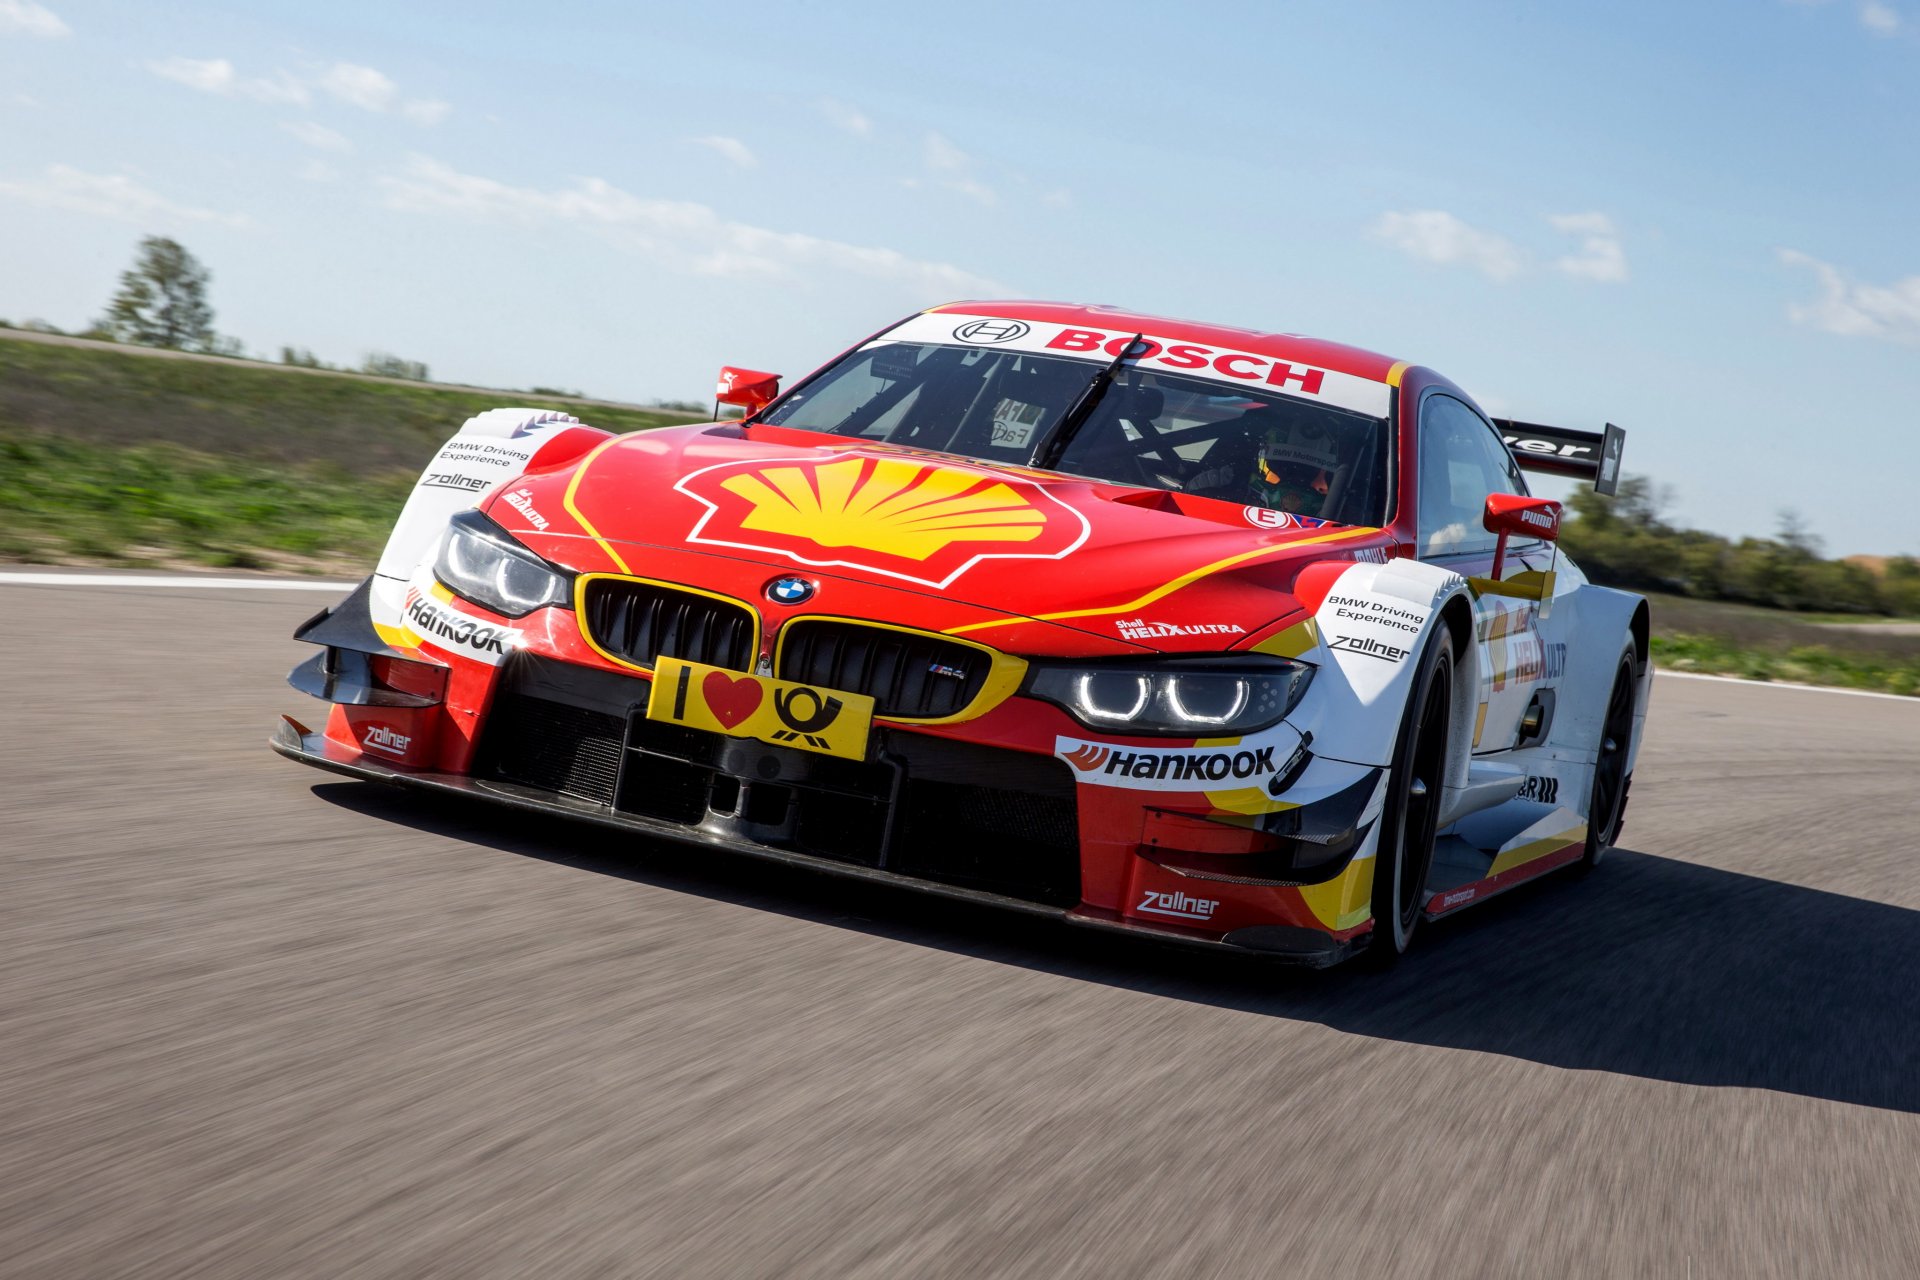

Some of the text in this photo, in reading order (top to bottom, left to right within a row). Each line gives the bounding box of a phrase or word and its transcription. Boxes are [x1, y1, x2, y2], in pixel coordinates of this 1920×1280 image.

[1044, 328, 1325, 395] BOSCH
[440, 451, 510, 467] Experience
[448, 442, 529, 461] BMW Driving
[1521, 510, 1553, 529] PUMA
[1328, 596, 1424, 624] BMW Driving
[1115, 618, 1145, 629] Shell
[1118, 621, 1247, 640] HELIX ULTRA
[1336, 608, 1419, 634] Experience
